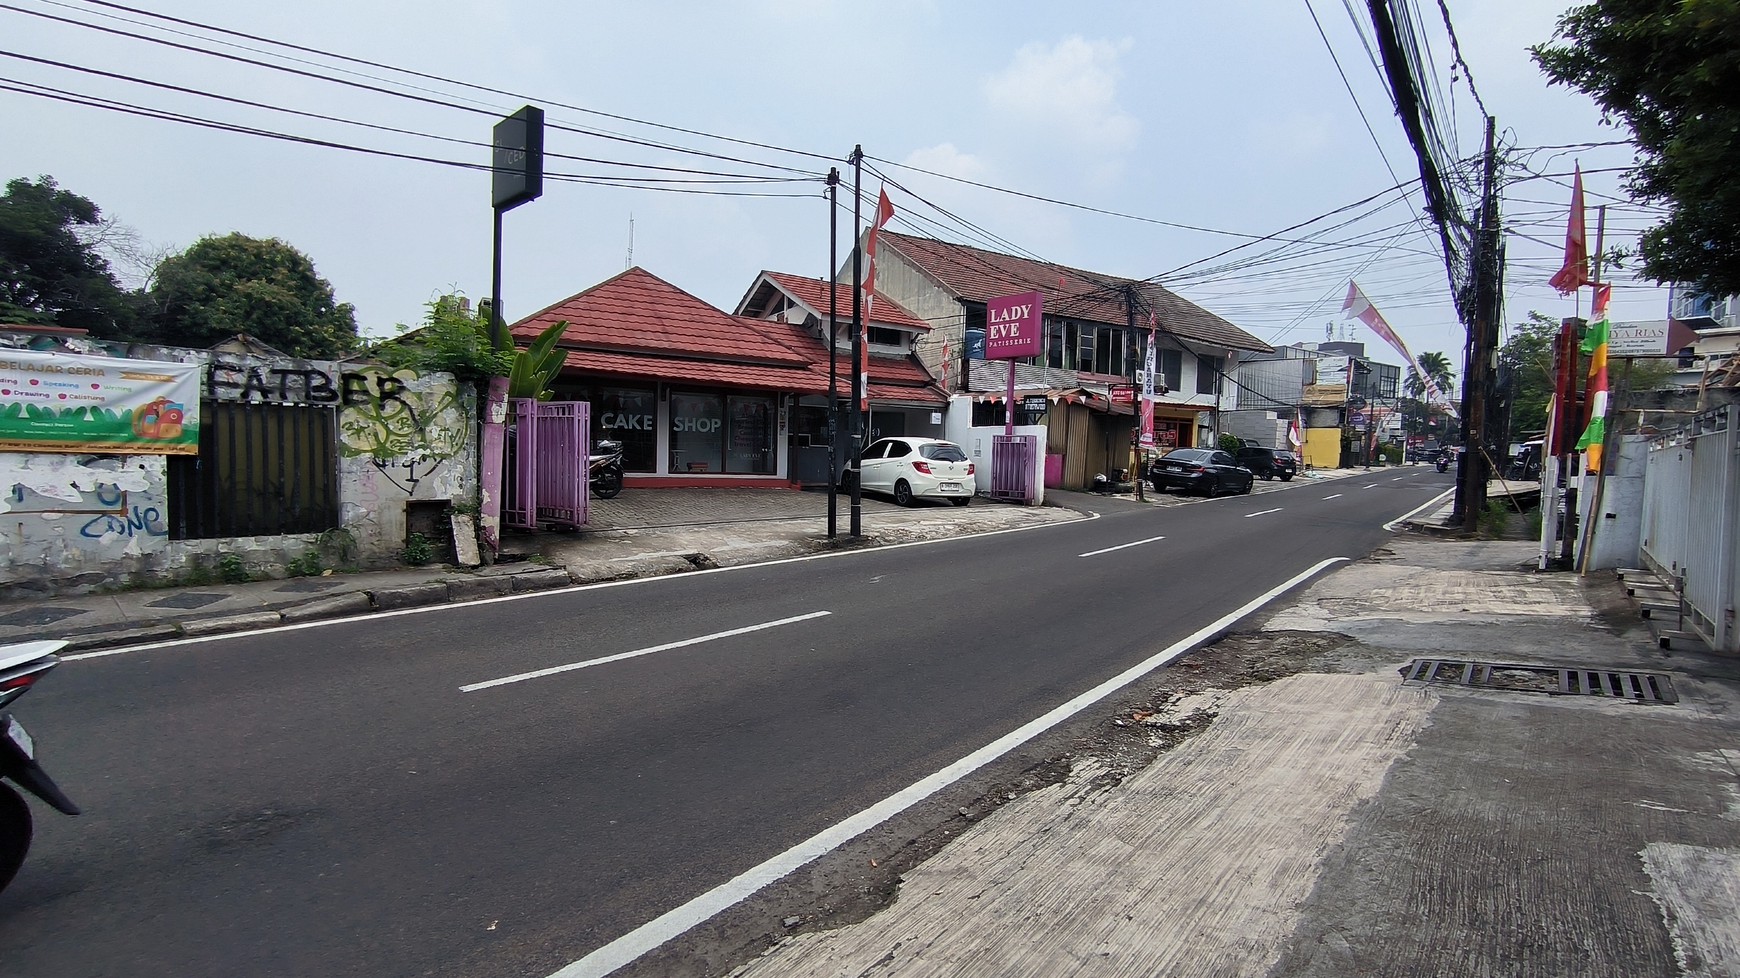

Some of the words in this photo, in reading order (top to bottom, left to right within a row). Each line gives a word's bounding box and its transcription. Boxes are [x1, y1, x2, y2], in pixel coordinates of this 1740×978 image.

[990, 304, 1032, 323] LADY
[990, 323, 1019, 339] EVE
[1635, 329, 1664, 337] RIAS
[989, 338, 1031, 347] PATISSERIE
[0, 361, 64, 374] BELAJAR
[67, 366, 105, 377] CERIA
[43, 381, 80, 389] Speaking
[103, 385, 133, 393] Writing
[14, 390, 50, 399] Drawing
[69, 393, 106, 402] Calistung
[601, 412, 653, 431] CAKE
[673, 417, 722, 432] SHOP
